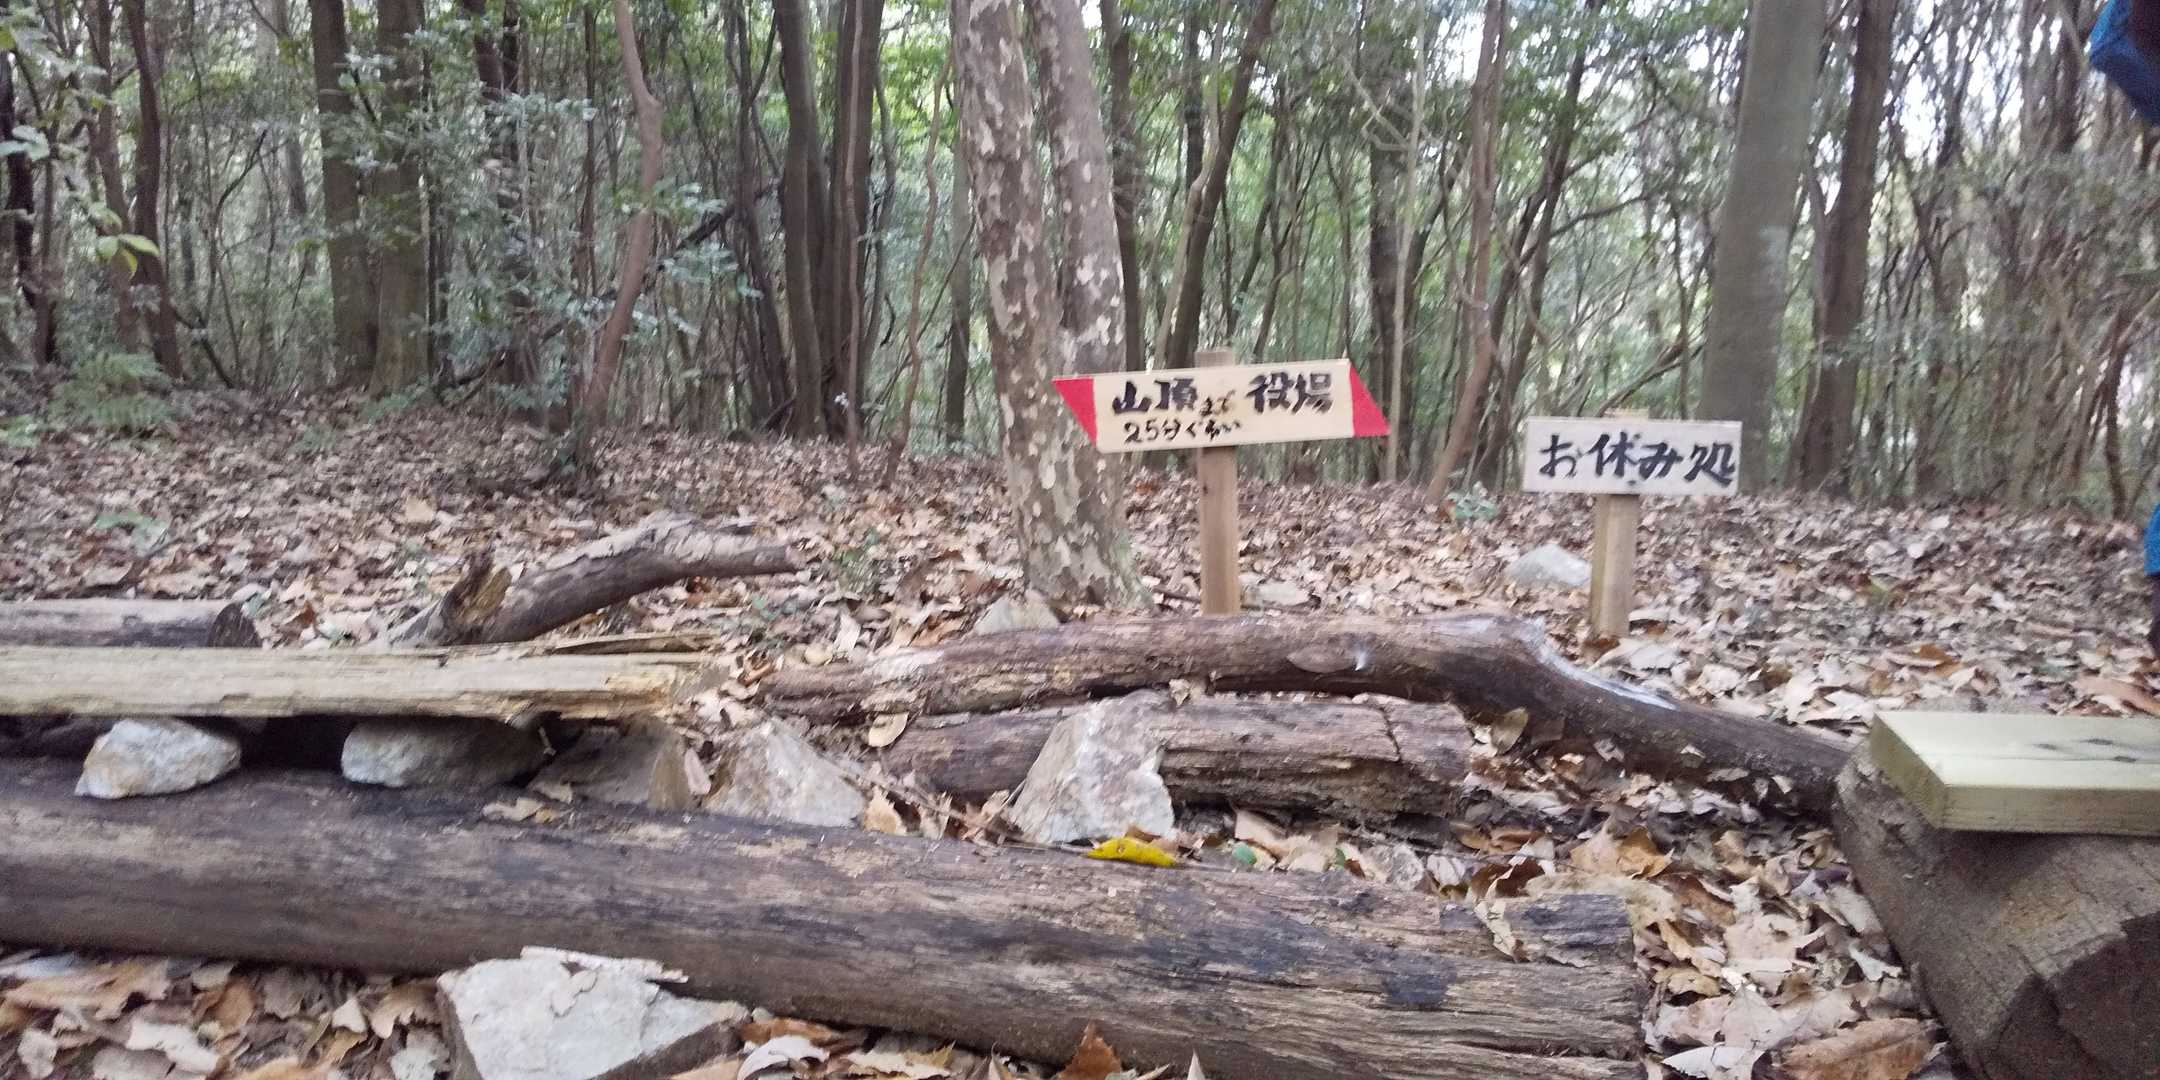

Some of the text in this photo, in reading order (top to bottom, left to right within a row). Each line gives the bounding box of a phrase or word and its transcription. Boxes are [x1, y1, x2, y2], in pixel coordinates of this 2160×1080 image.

[1246, 372, 1333, 414] 役場
[1539, 430, 1736, 487] お休み処
